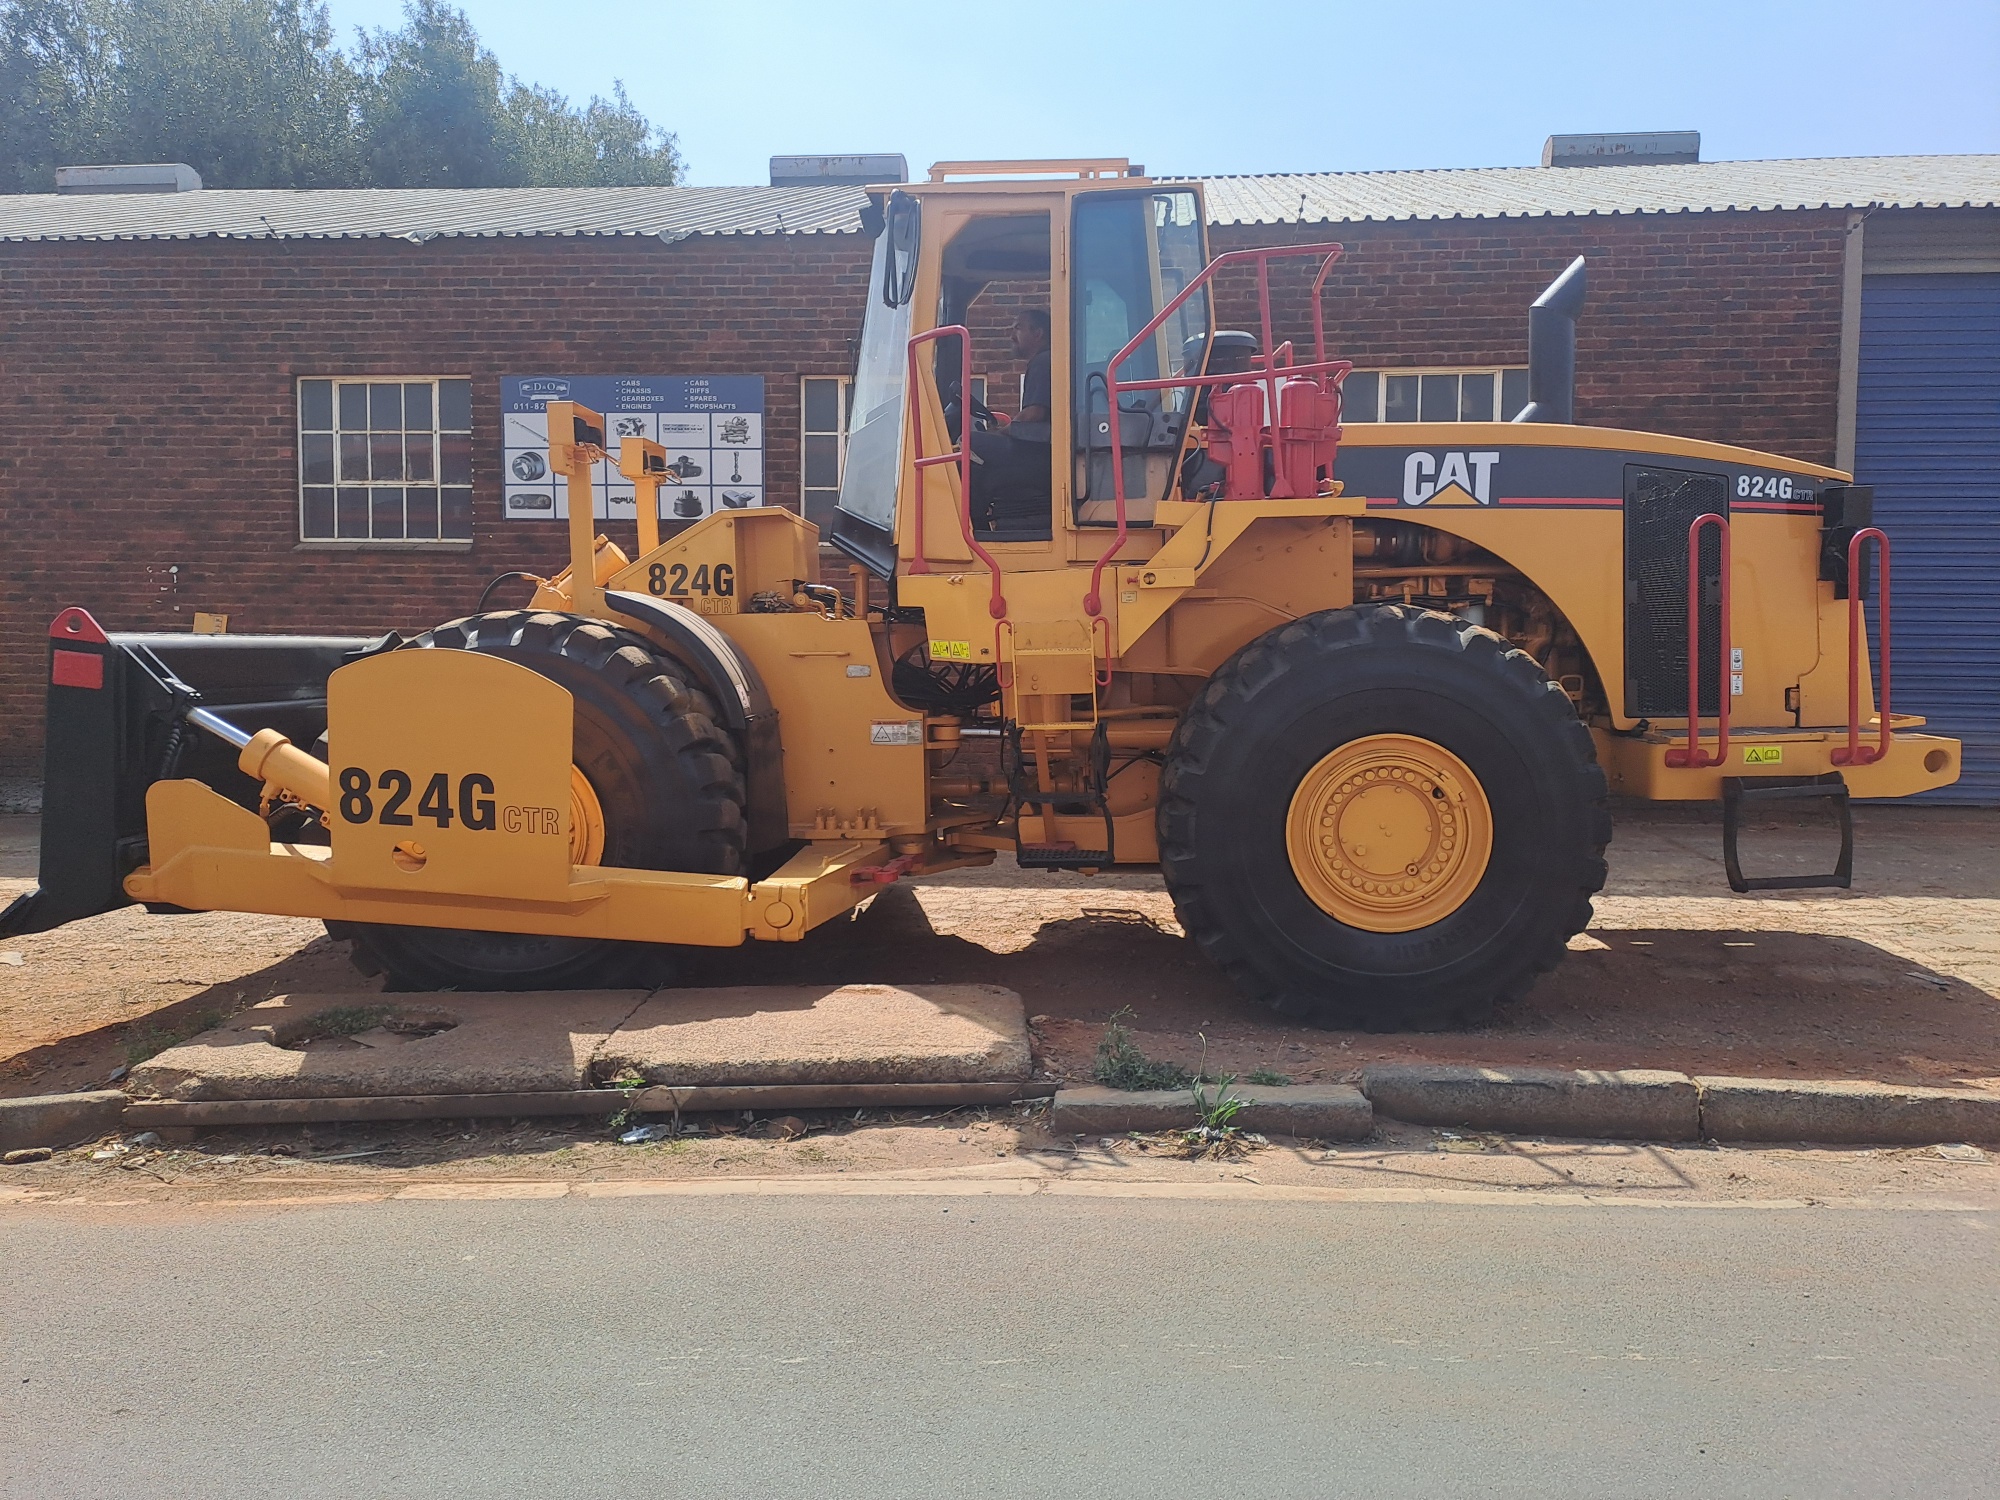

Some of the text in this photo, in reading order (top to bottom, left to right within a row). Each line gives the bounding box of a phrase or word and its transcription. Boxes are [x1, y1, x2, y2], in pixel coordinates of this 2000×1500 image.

[513, 402, 548, 410] 011-82
[1403, 451, 1500, 506] CAT
[1737, 475, 1814, 501] 824G CTR
[648, 563, 735, 597] 824G
[700, 597, 732, 614] CTR
[339, 766, 560, 836] 824G CTR
